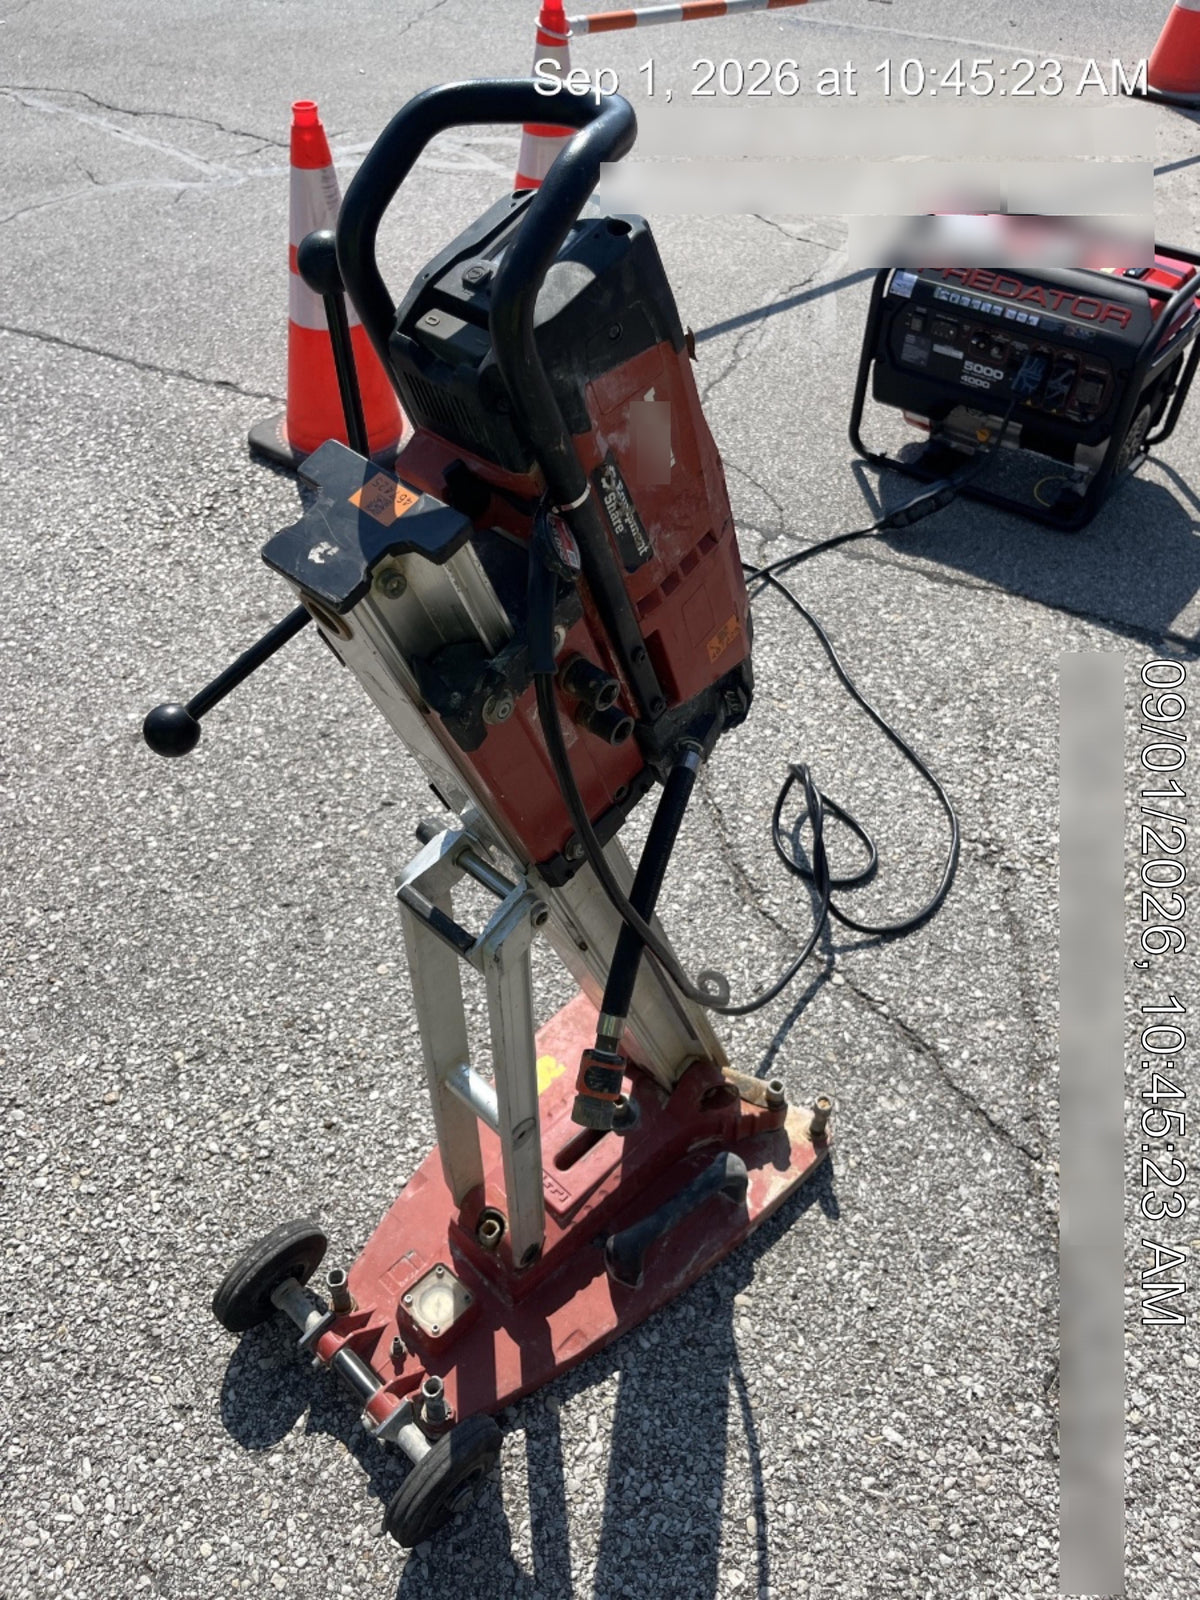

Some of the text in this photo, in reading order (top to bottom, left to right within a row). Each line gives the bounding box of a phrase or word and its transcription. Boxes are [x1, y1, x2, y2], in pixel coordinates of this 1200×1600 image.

[917, 267, 1133, 330] REDATOR
[960, 375, 991, 389] 4000
[963, 360, 1004, 381] 5000
[604, 492, 625, 534] Share
